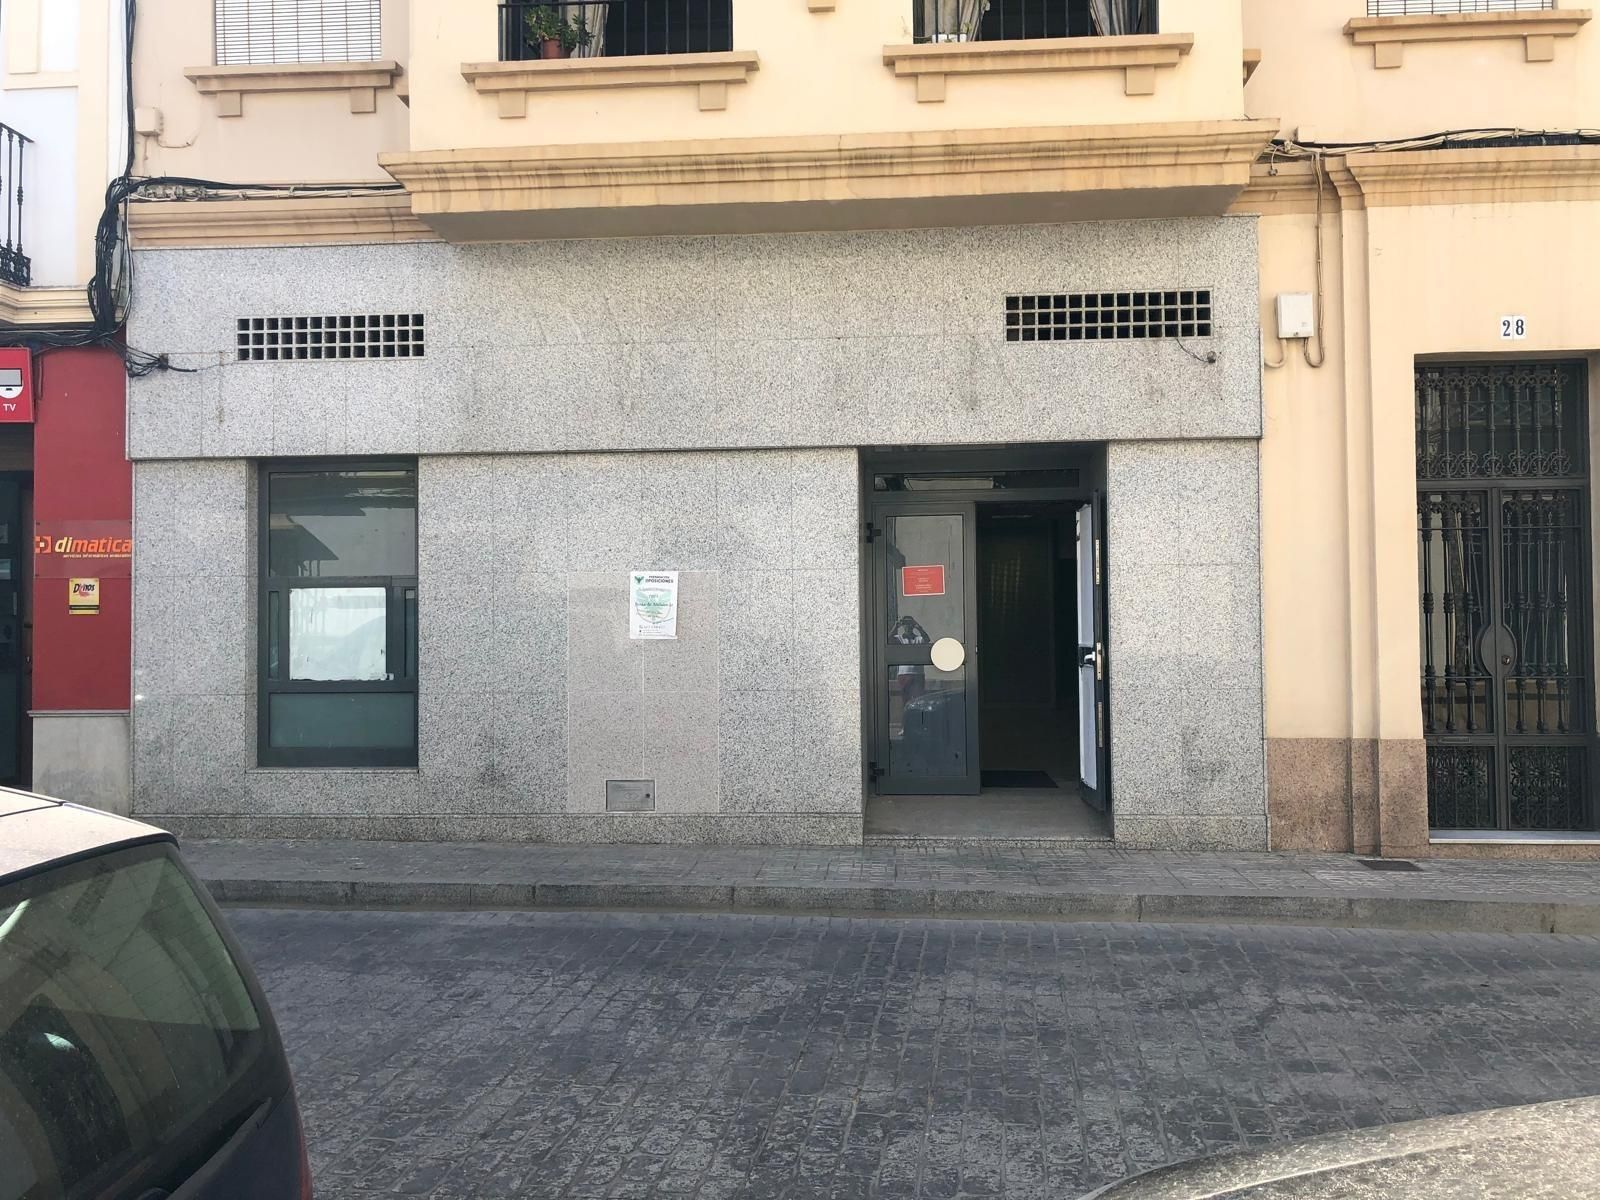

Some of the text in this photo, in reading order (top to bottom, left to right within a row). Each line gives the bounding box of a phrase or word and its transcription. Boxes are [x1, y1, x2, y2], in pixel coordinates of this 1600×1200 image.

[1502, 319, 1524, 336] 28
[3, 404, 16, 412] TV
[54, 537, 132, 553] dimatica
